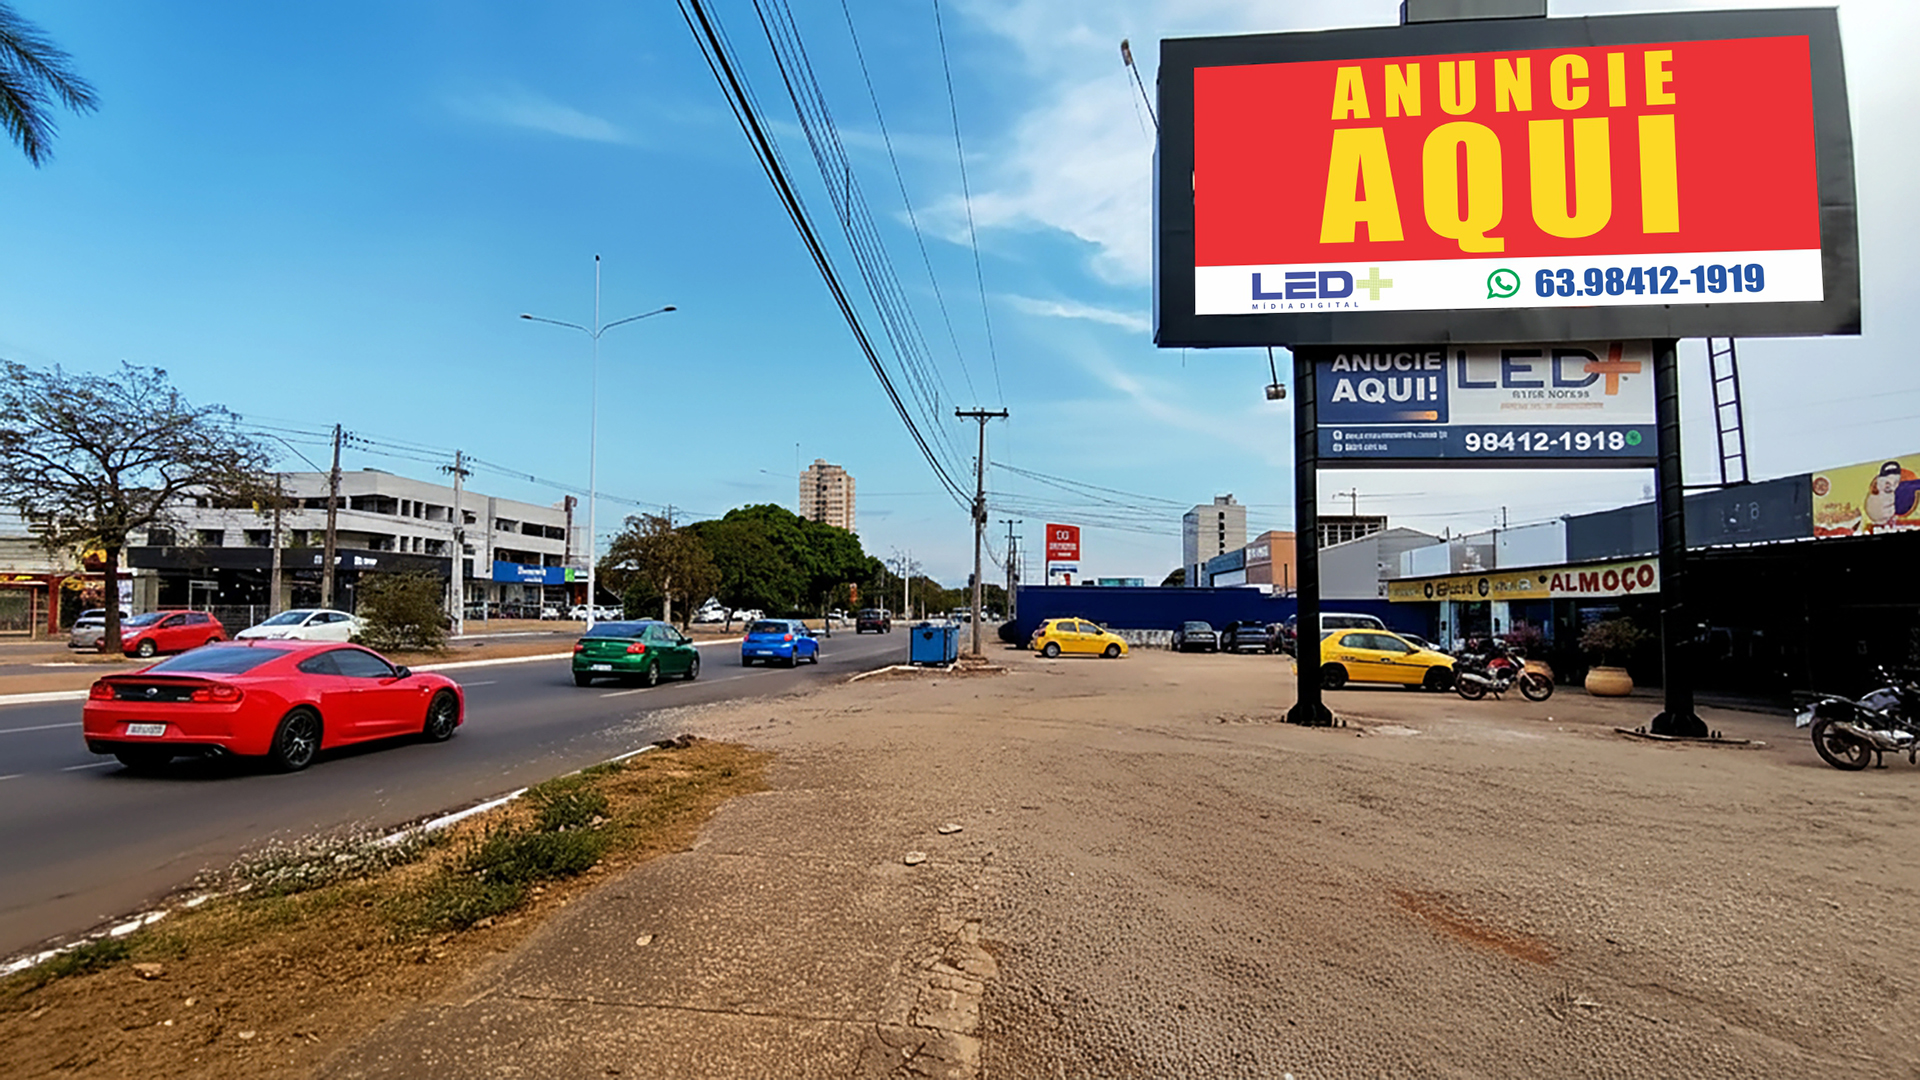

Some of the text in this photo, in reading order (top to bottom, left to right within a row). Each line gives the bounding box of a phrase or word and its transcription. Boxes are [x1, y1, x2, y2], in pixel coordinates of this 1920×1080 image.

[1331, 49, 1676, 121] ANUNCIE
[1318, 113, 1680, 254] AQUI
[1535, 263, 1765, 298] 63.98412-1919
[1300, 301, 1359, 309] DIGITAL
[1331, 351, 1442, 373] ANUCIE
[1331, 376, 1438, 405] AQUI!
[1464, 430, 1625, 452] 98412-1918
[1549, 563, 1655, 594] ALMOÇO
